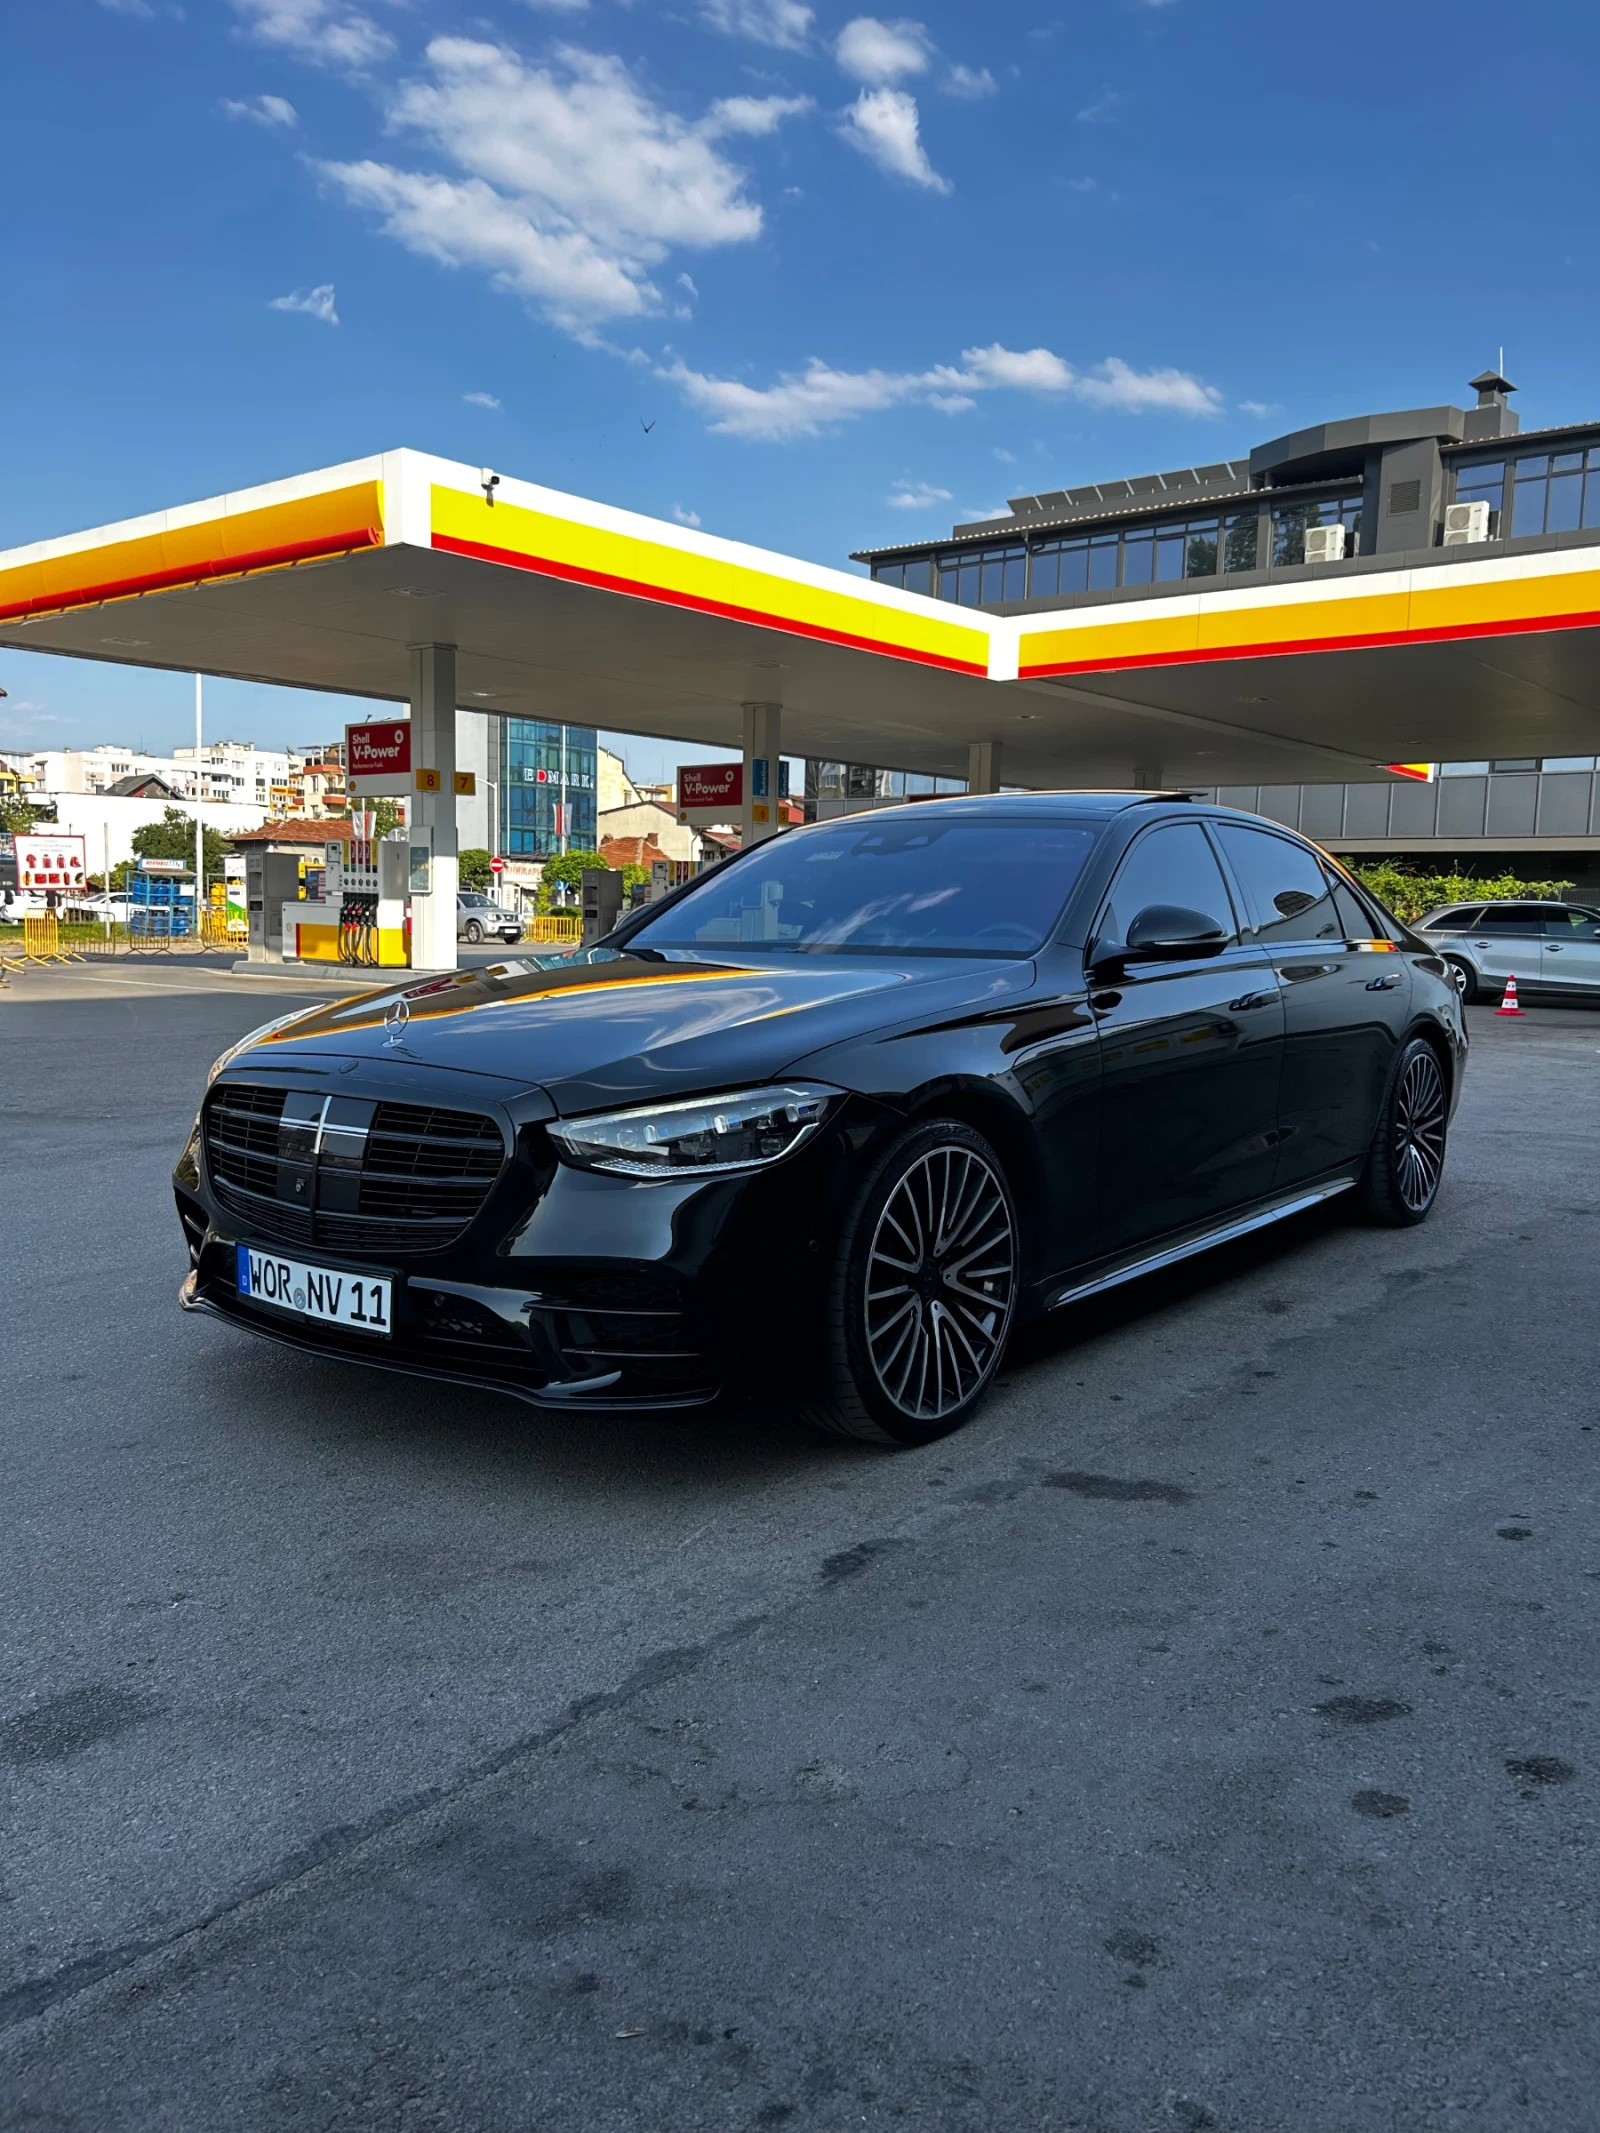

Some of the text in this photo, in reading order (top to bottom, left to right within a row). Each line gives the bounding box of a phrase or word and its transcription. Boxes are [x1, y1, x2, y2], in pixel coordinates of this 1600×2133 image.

[352, 733, 370, 744] Shell
[353, 745, 400, 760] V-Power
[426, 774, 435, 787] 8
[460, 777, 468, 789] 7
[684, 773, 702, 783] Shell
[684, 783, 730, 795] V-Power
[760, 809, 766, 820] 6
[781, 810, 787, 821] 5
[240, 1275, 248, 1287] D
[250, 1255, 387, 1327] WOR NV 11
